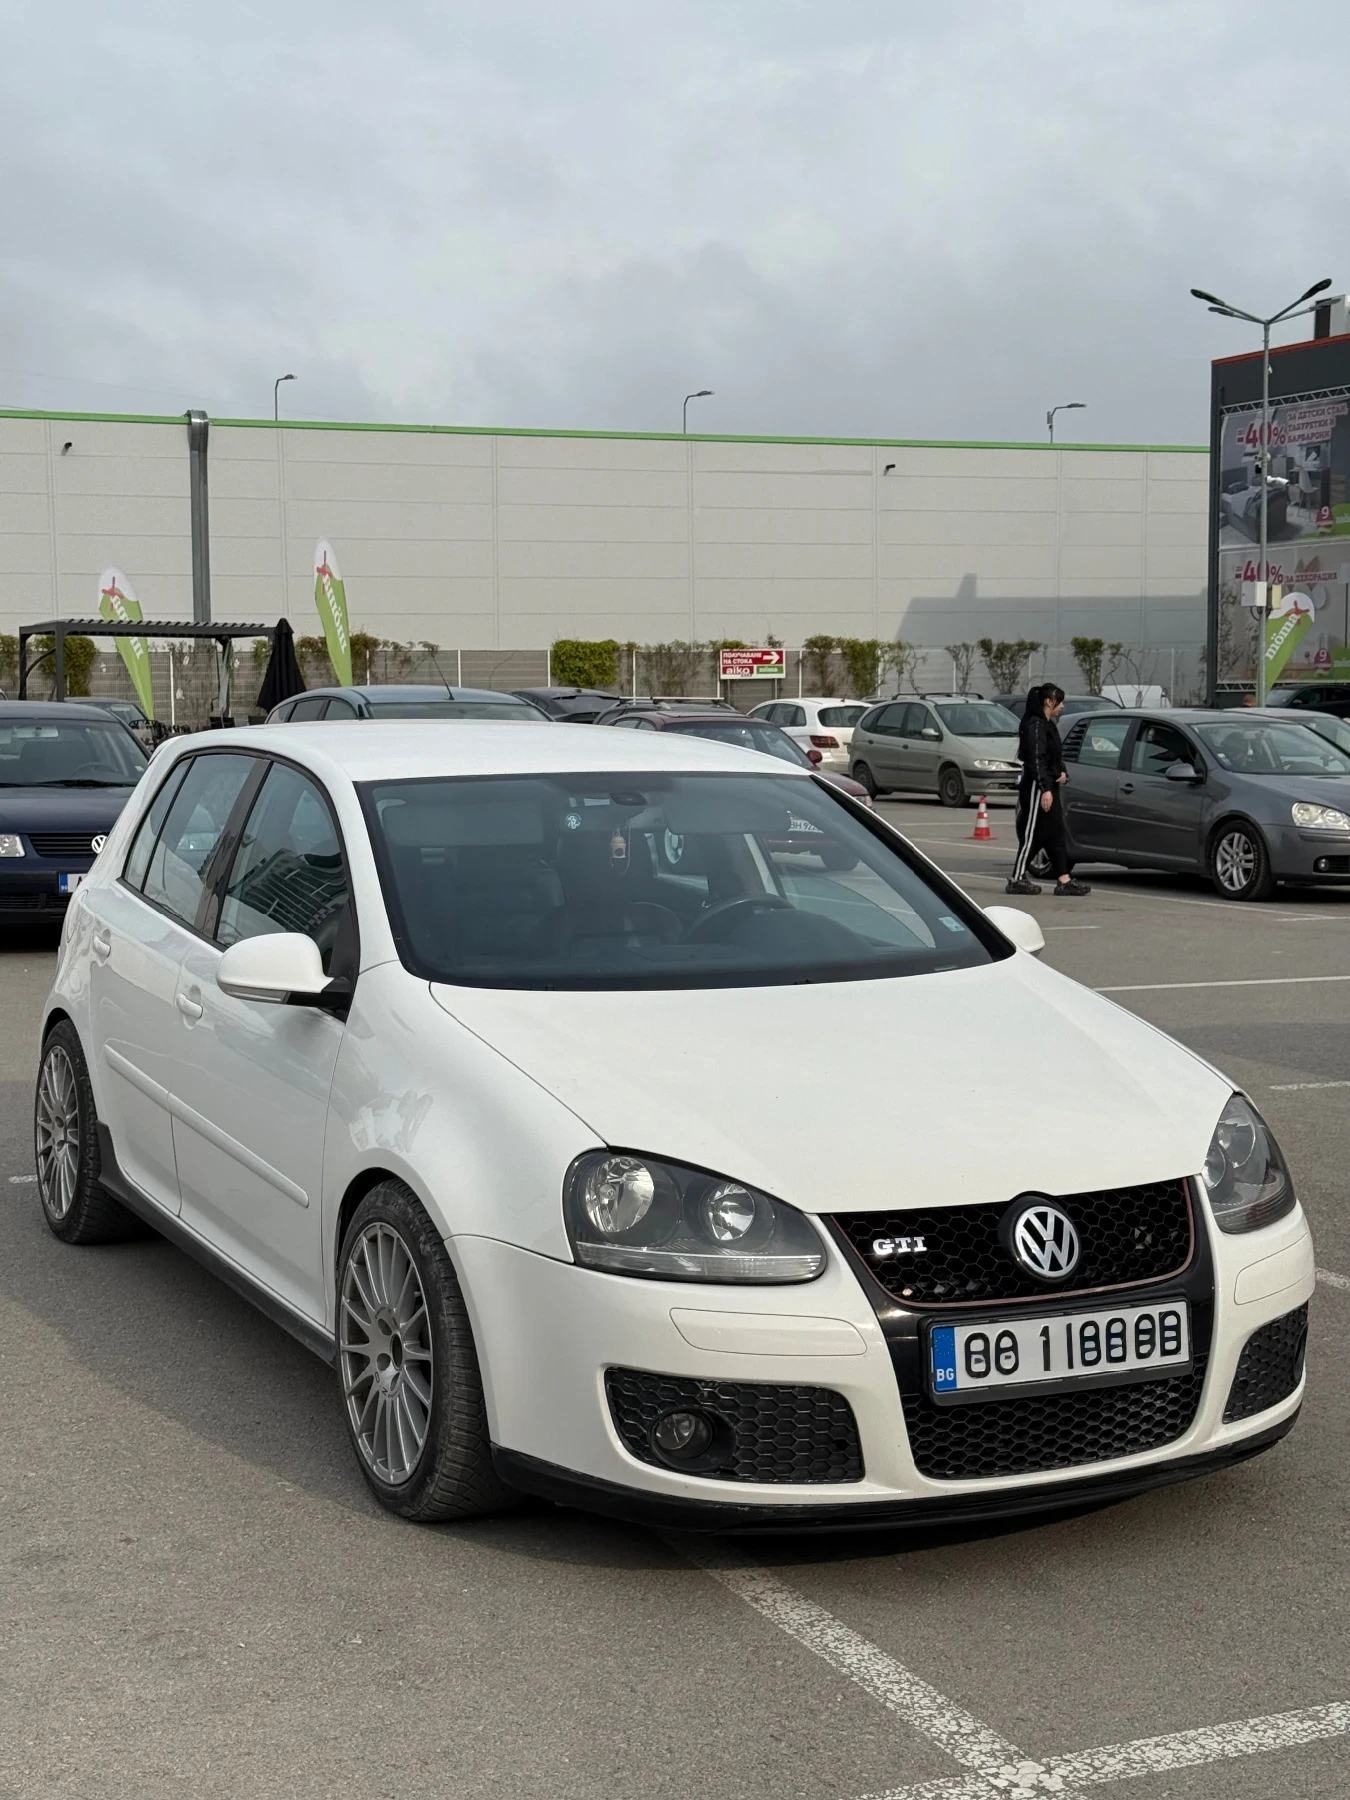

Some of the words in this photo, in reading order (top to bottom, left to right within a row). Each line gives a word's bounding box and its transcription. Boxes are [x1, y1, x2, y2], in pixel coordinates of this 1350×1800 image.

[1265, 613, 1301, 660] möma
[726, 666, 750, 675] aiko
[872, 1236, 927, 1256] GTI
[936, 1368, 955, 1382] BG
